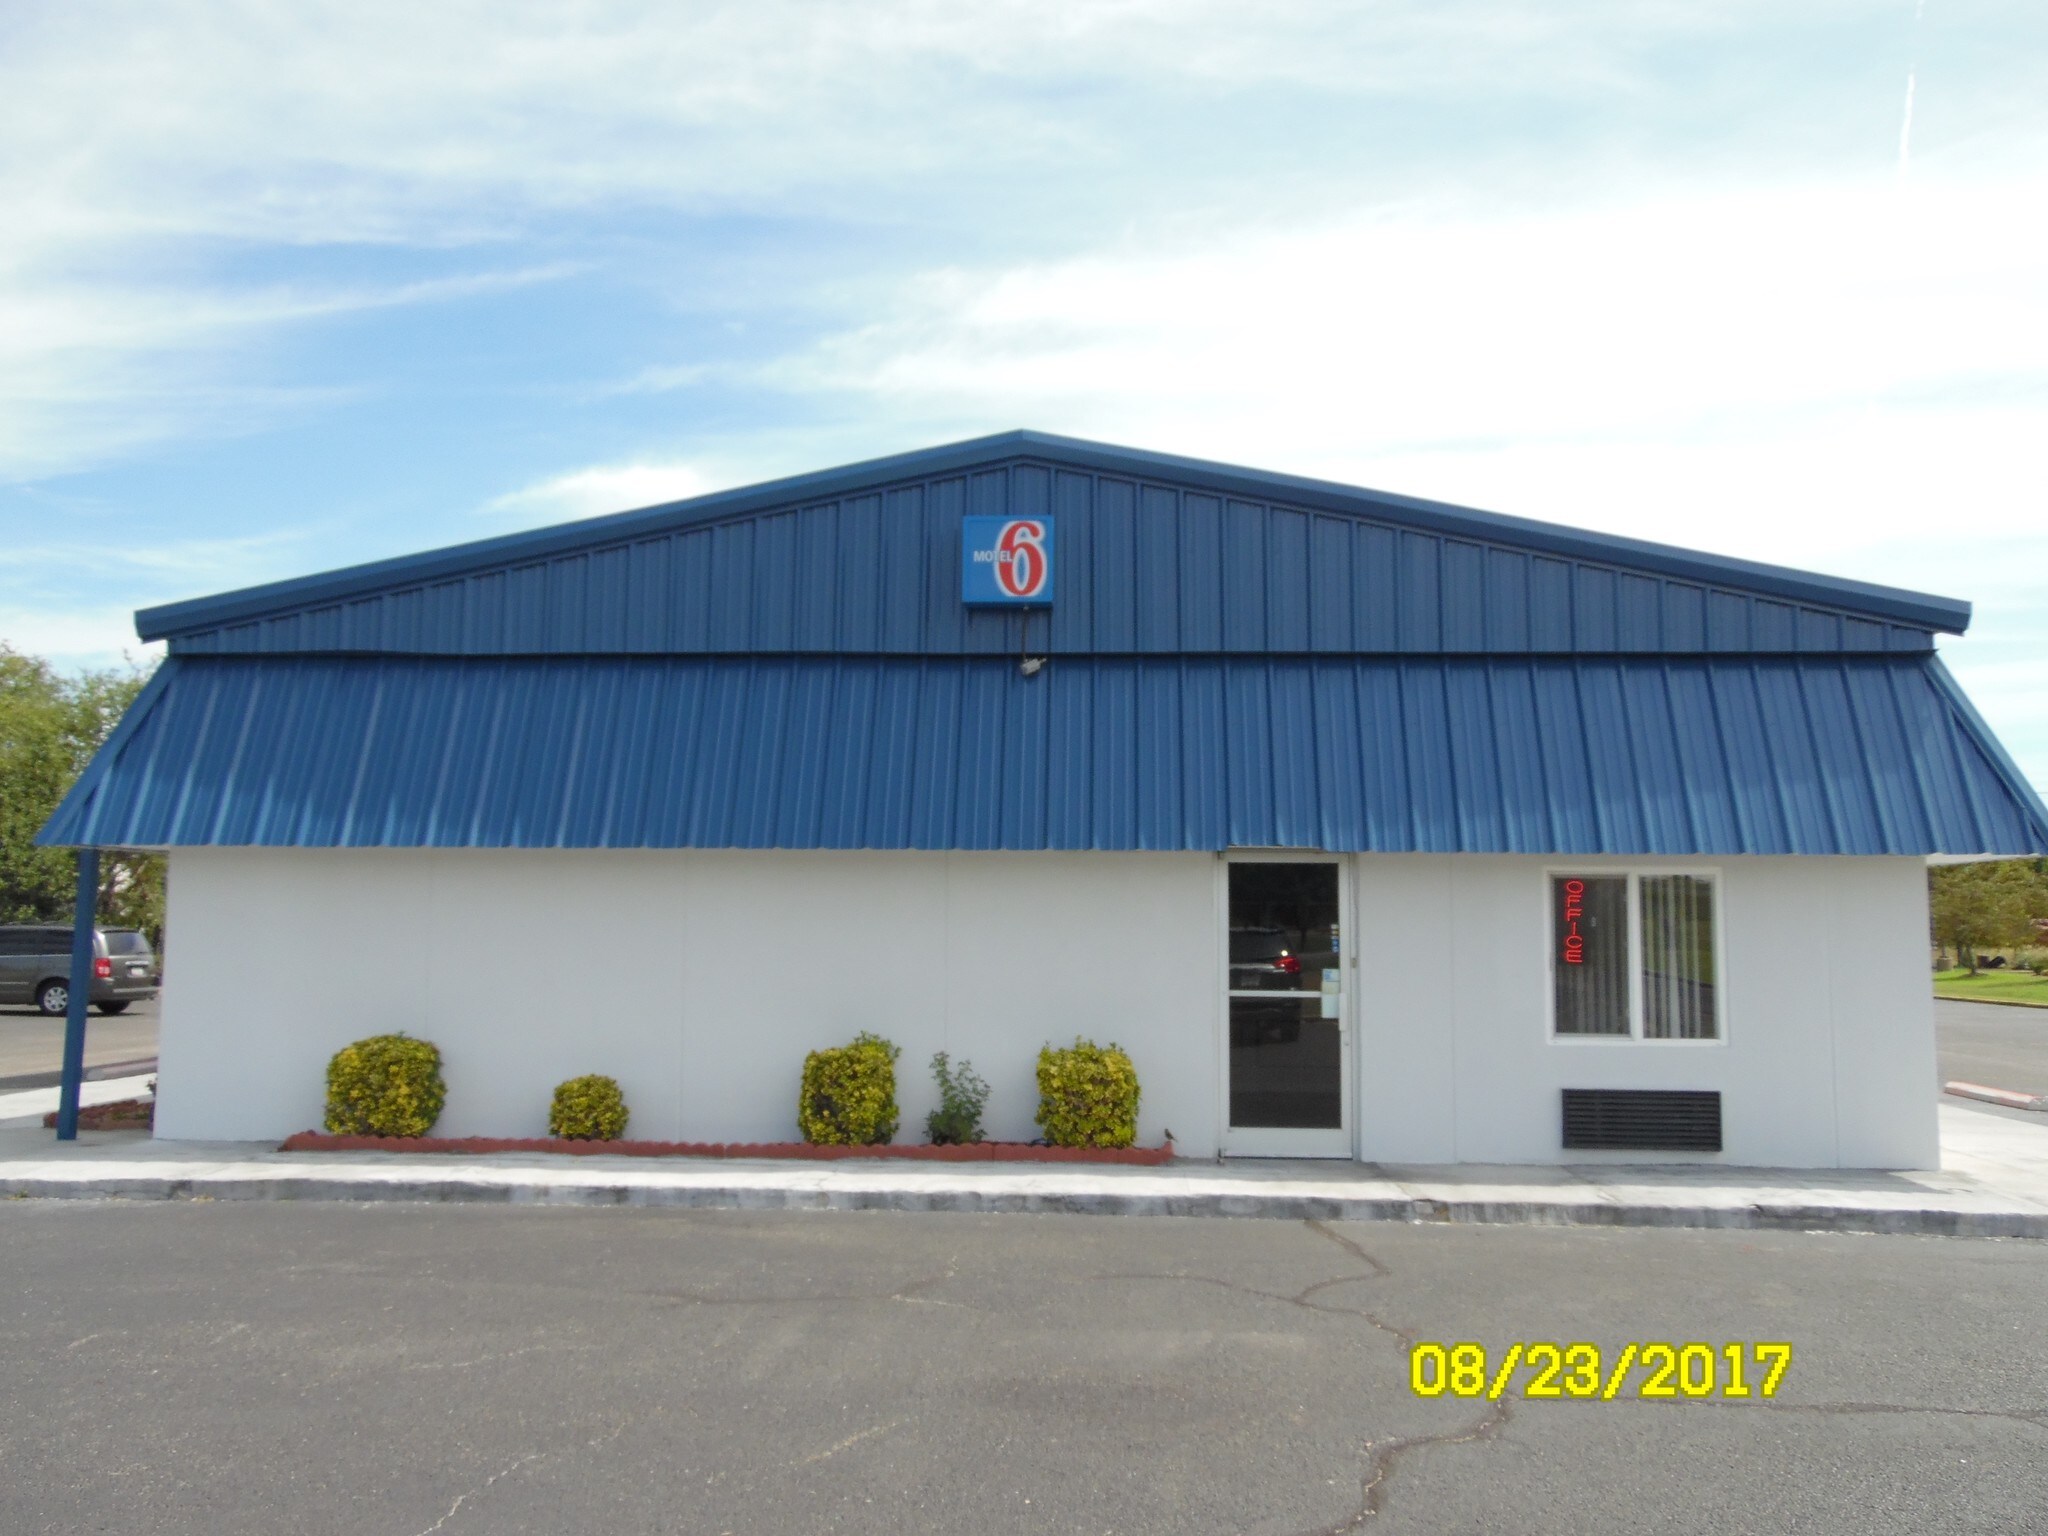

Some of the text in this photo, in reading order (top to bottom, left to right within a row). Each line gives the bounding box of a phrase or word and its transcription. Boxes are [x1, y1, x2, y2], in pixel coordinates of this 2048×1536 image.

[973, 520, 1045, 597] MOTEL 6
[1566, 880, 1584, 963] OFFICE
